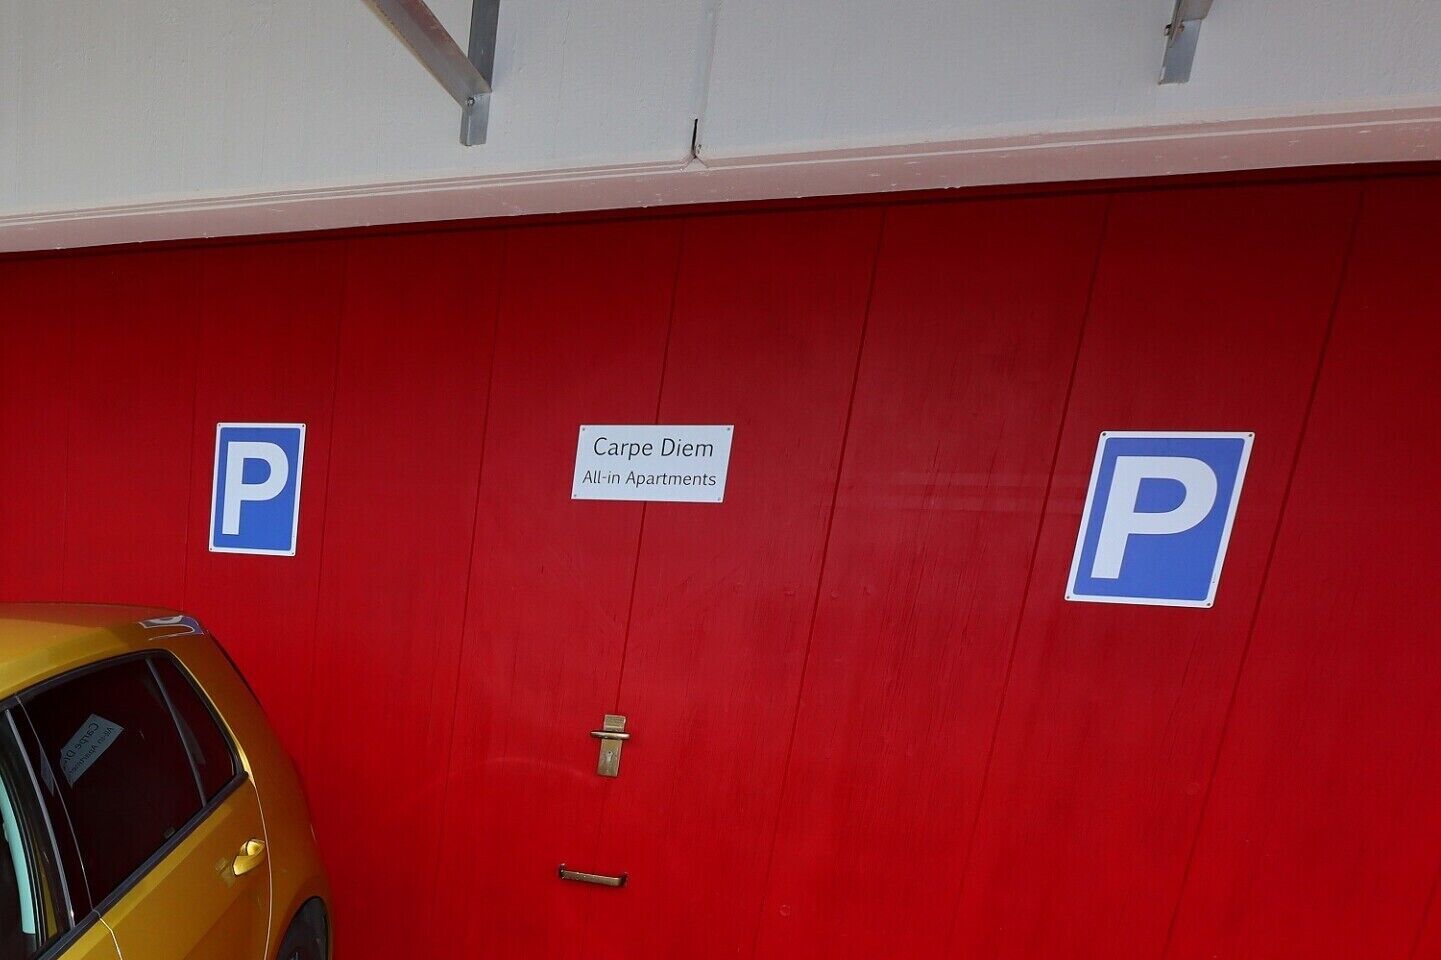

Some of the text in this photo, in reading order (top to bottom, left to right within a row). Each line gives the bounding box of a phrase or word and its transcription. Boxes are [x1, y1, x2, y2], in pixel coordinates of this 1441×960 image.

[593, 437, 714, 460] Carpe Diem
[222, 441, 289, 535] P
[582, 470, 717, 488] All-in Apartments
[1090, 456, 1218, 579] P
